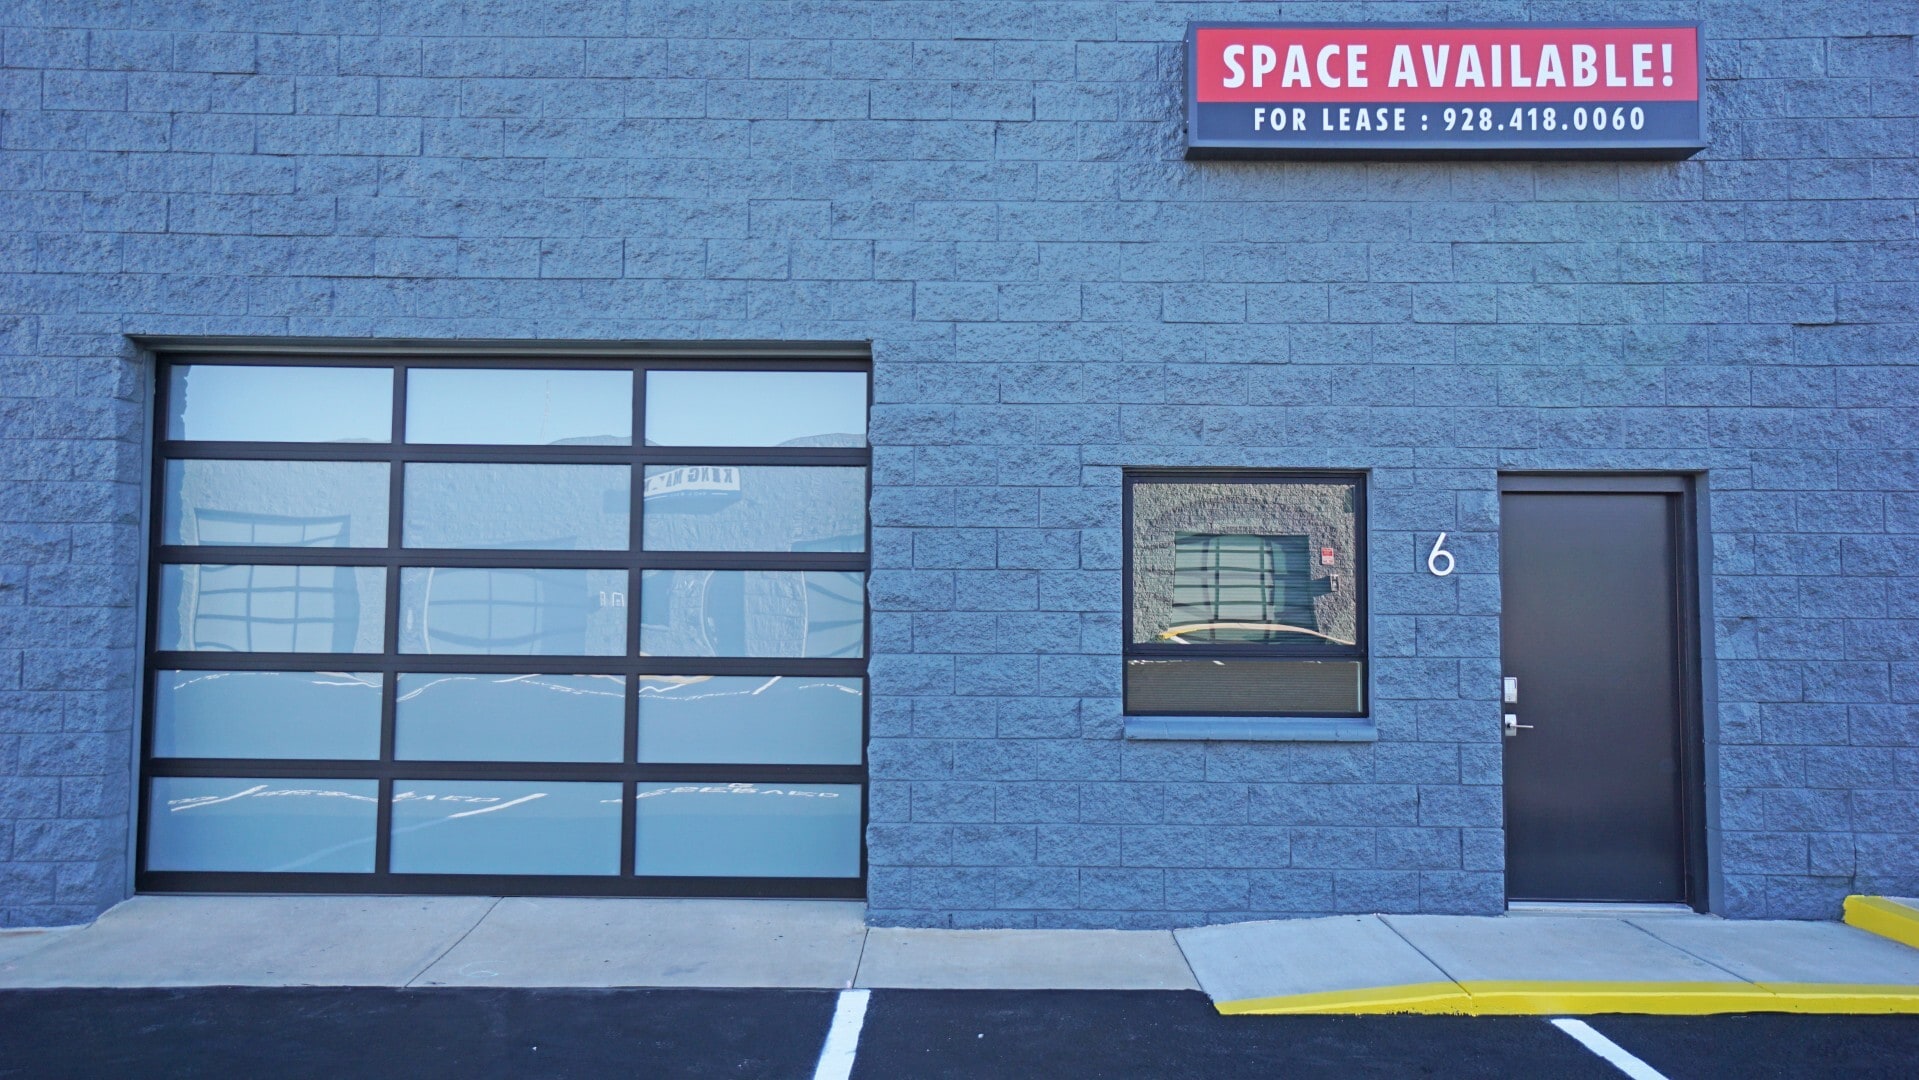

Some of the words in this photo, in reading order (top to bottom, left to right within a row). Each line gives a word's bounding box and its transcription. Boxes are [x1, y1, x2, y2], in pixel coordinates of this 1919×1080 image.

[1222, 43, 1369, 89] SPACE
[1387, 42, 1674, 88] AVAILABLE!
[1253, 107, 1307, 132] FOR
[1322, 107, 1407, 132] LEASE
[1442, 106, 1646, 132] 928.418.0060
[1427, 531, 1456, 577] 6
